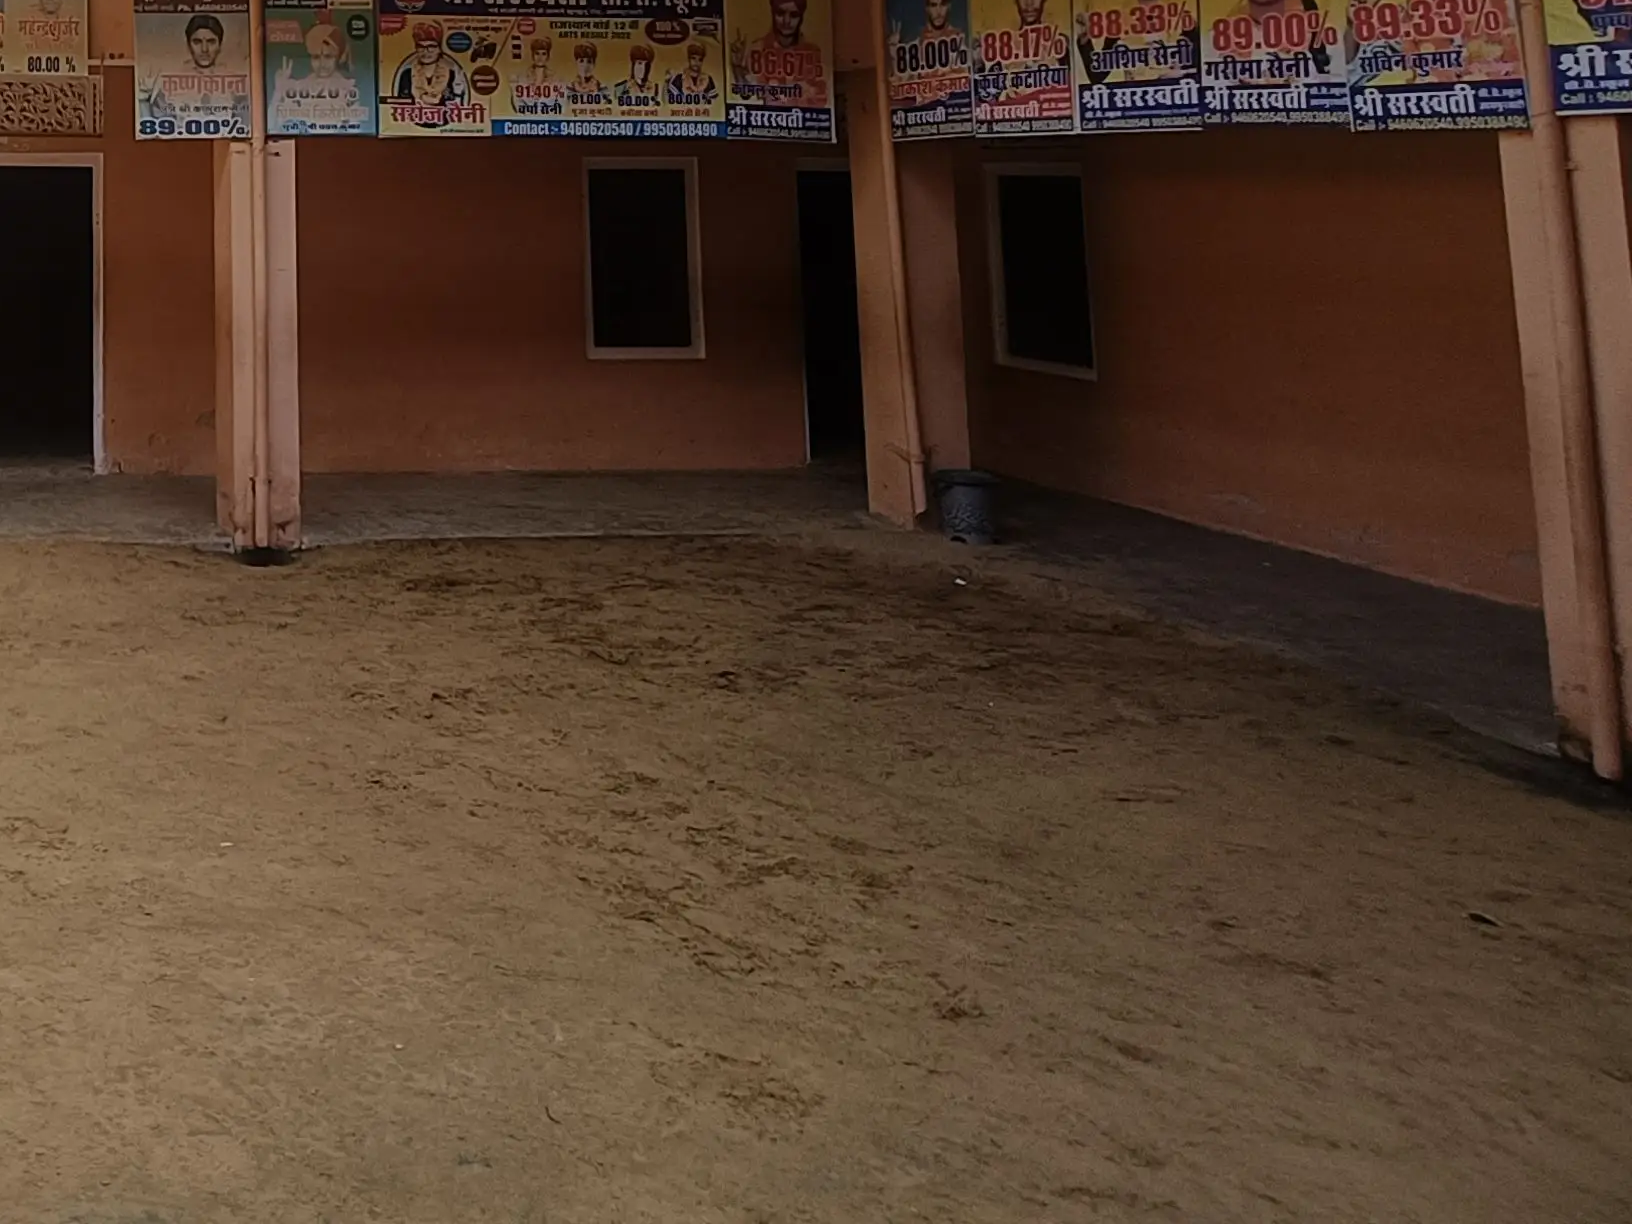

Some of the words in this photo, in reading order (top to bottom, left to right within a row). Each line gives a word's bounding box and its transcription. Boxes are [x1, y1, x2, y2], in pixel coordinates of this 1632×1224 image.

[614, 21, 626, 31] 12
[1088, 1, 1195, 40] 88.33%
[1212, 9, 1338, 52] 89.00%
[896, 34, 968, 74] 88.00%
[982, 25, 1066, 64] 88.17%
[28, 56, 60, 72] 80.00
[66, 56, 76, 73] %
[749, 50, 824, 78] 86.67%
[1263, 50, 1311, 79] सैनी
[1411, 50, 1464, 78] कुमार
[1557, 44, 1609, 77] श्री
[1010, 64, 1069, 89] कटारिया
[1081, 85, 1111, 109] श्री
[1112, 80, 1201, 108] सरस्वती
[1205, 85, 1231, 110] श्री
[1232, 82, 1309, 110] सरस्वती
[1354, 88, 1387, 117] श्री
[1387, 84, 1477, 115] सरस्वती
[1561, 89, 1587, 105] Call
[728, 106, 748, 125] श्री
[749, 108, 804, 127] सरस्वती
[906, 106, 947, 124] सरस्वती
[975, 103, 993, 123] श्री
[993, 100, 1040, 120] सरस्वती
[560, 122, 633, 136] 9460620540
[644, 123, 718, 136] 9950388490
